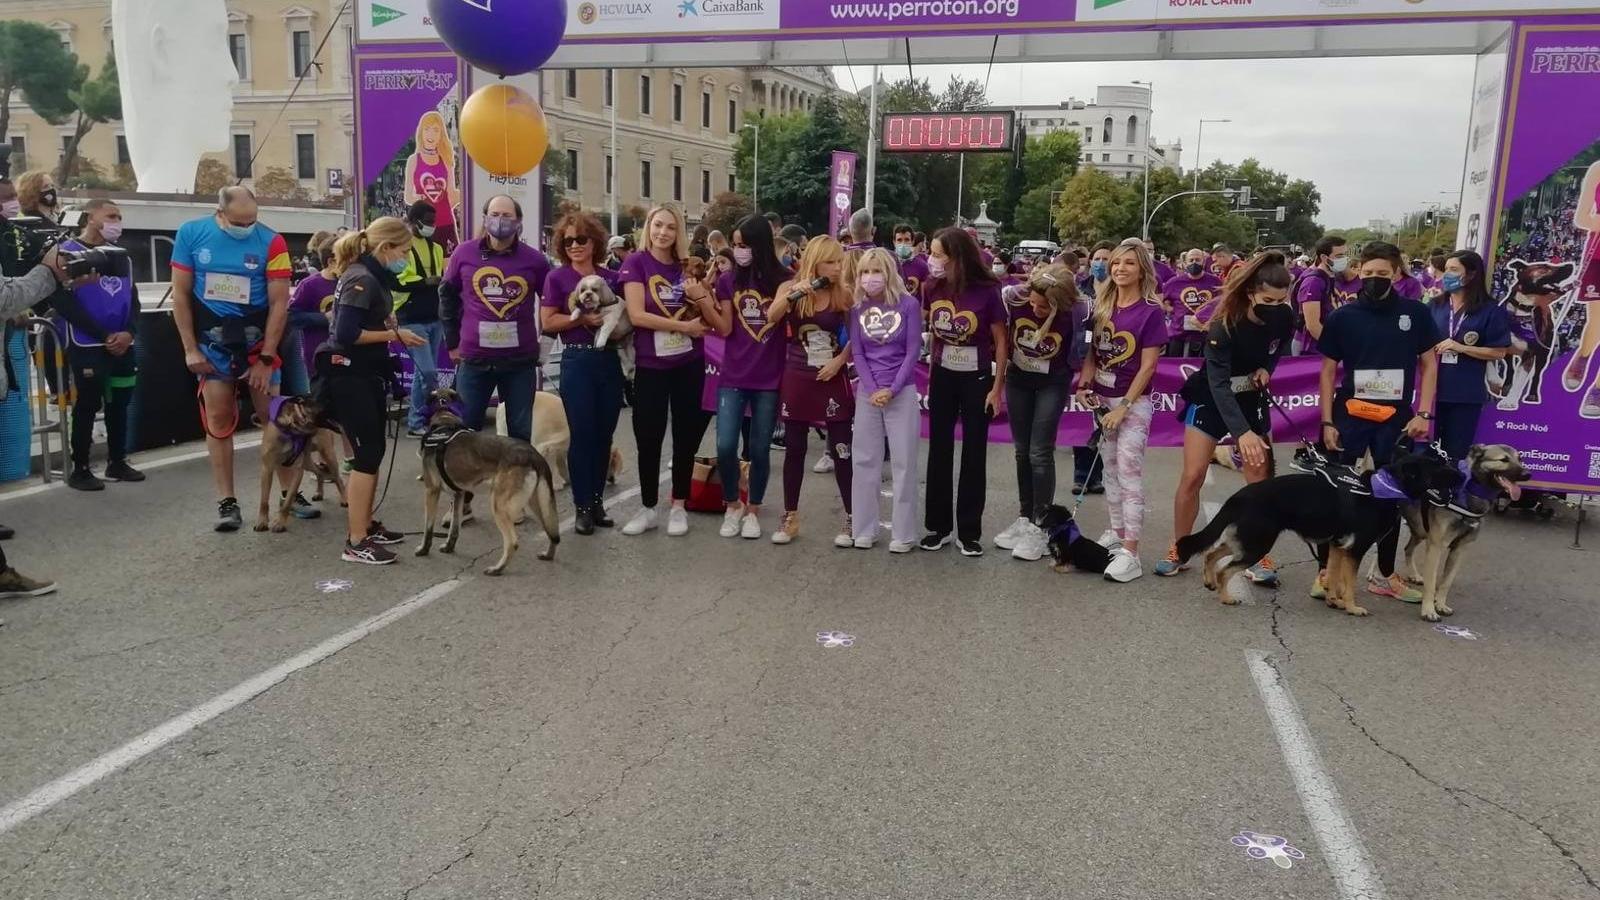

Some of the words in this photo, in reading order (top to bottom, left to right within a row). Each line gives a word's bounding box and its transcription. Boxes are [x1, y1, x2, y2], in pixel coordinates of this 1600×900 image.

[702, 0, 764, 13] CaixaBank
[830, 0, 1020, 20] www.perroton.org
[1506, 421, 1529, 431] Rock
[1530, 424, 1549, 433] Noé
